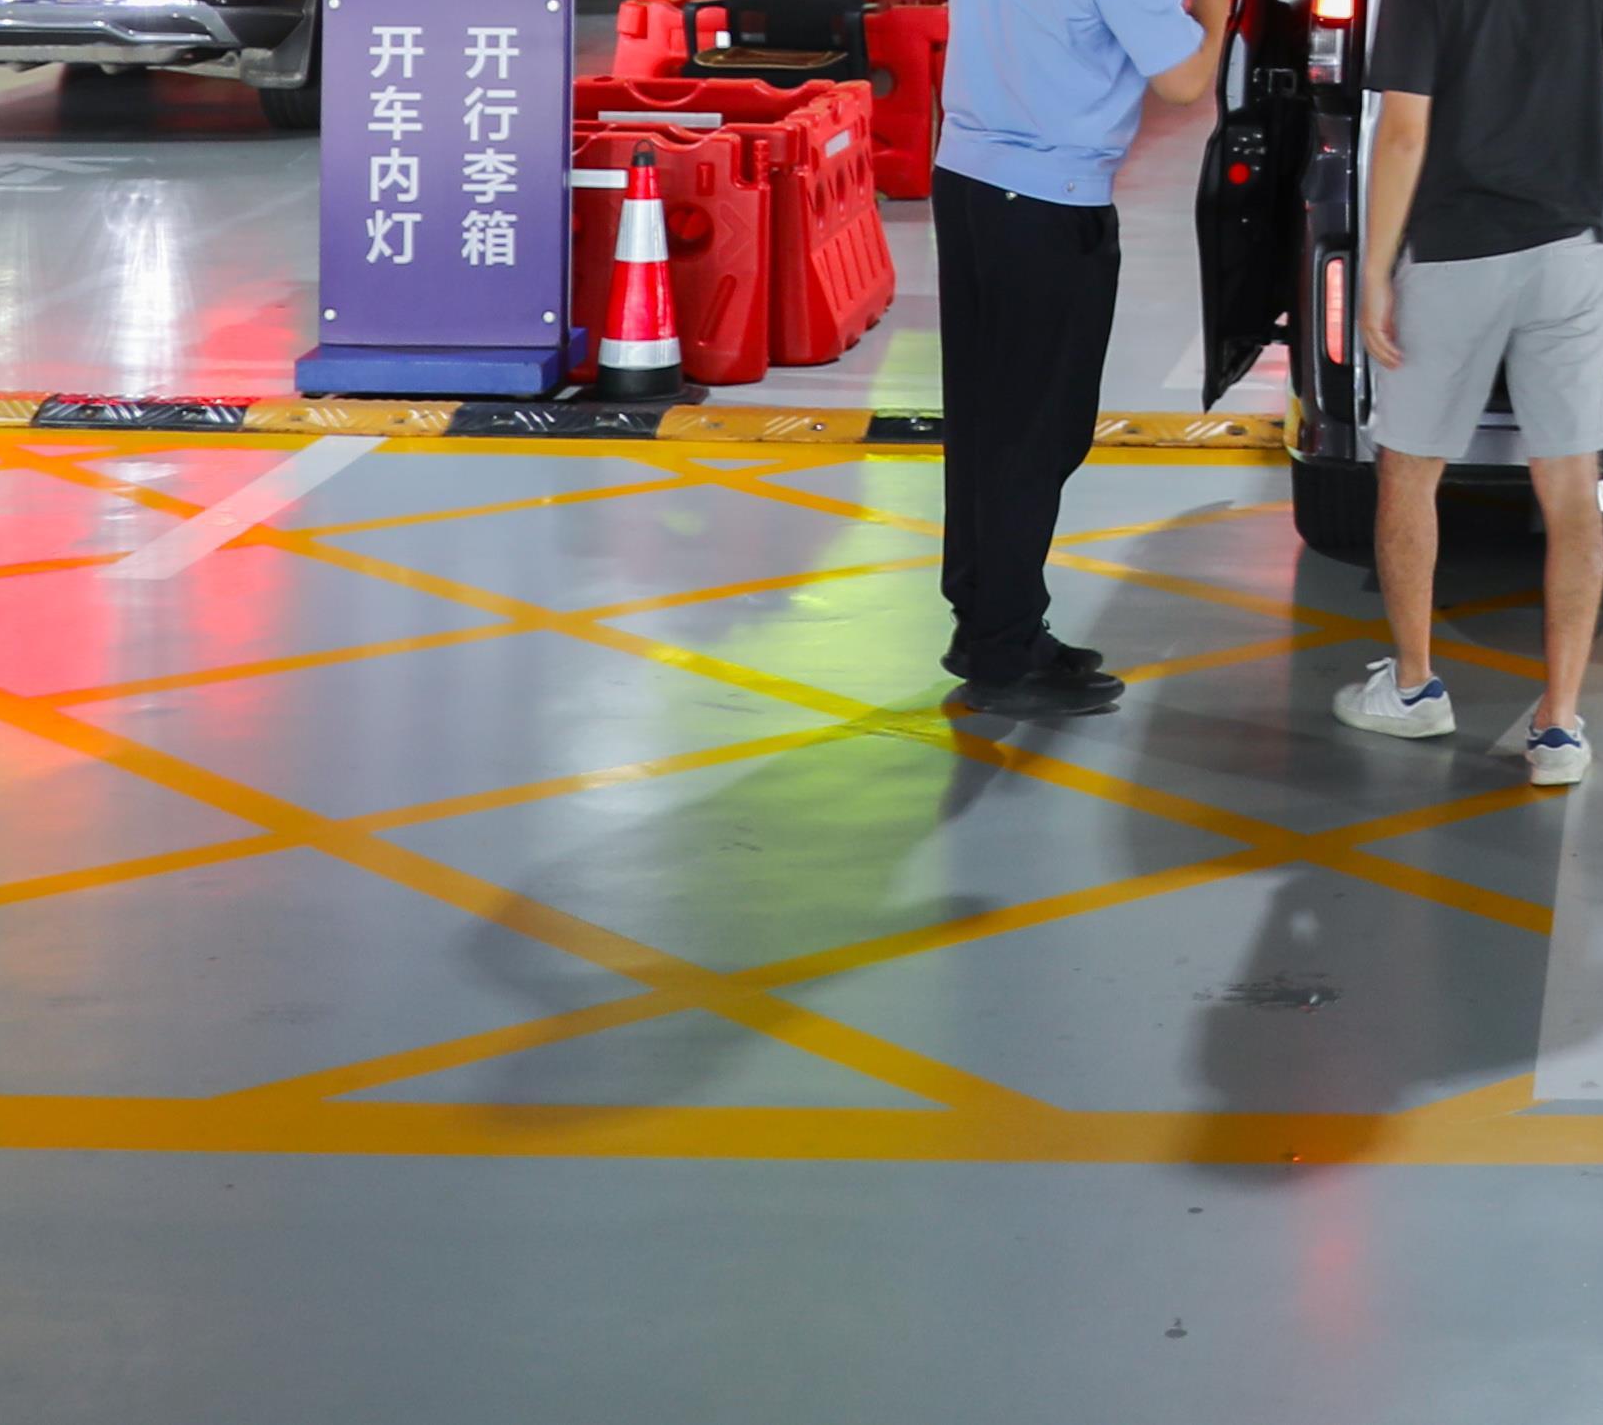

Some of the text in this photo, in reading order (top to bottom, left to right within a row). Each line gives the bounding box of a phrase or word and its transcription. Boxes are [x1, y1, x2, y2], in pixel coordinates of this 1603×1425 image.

[365, 26, 425, 266] 开车内灯
[461, 26, 519, 268] 开行李箱
